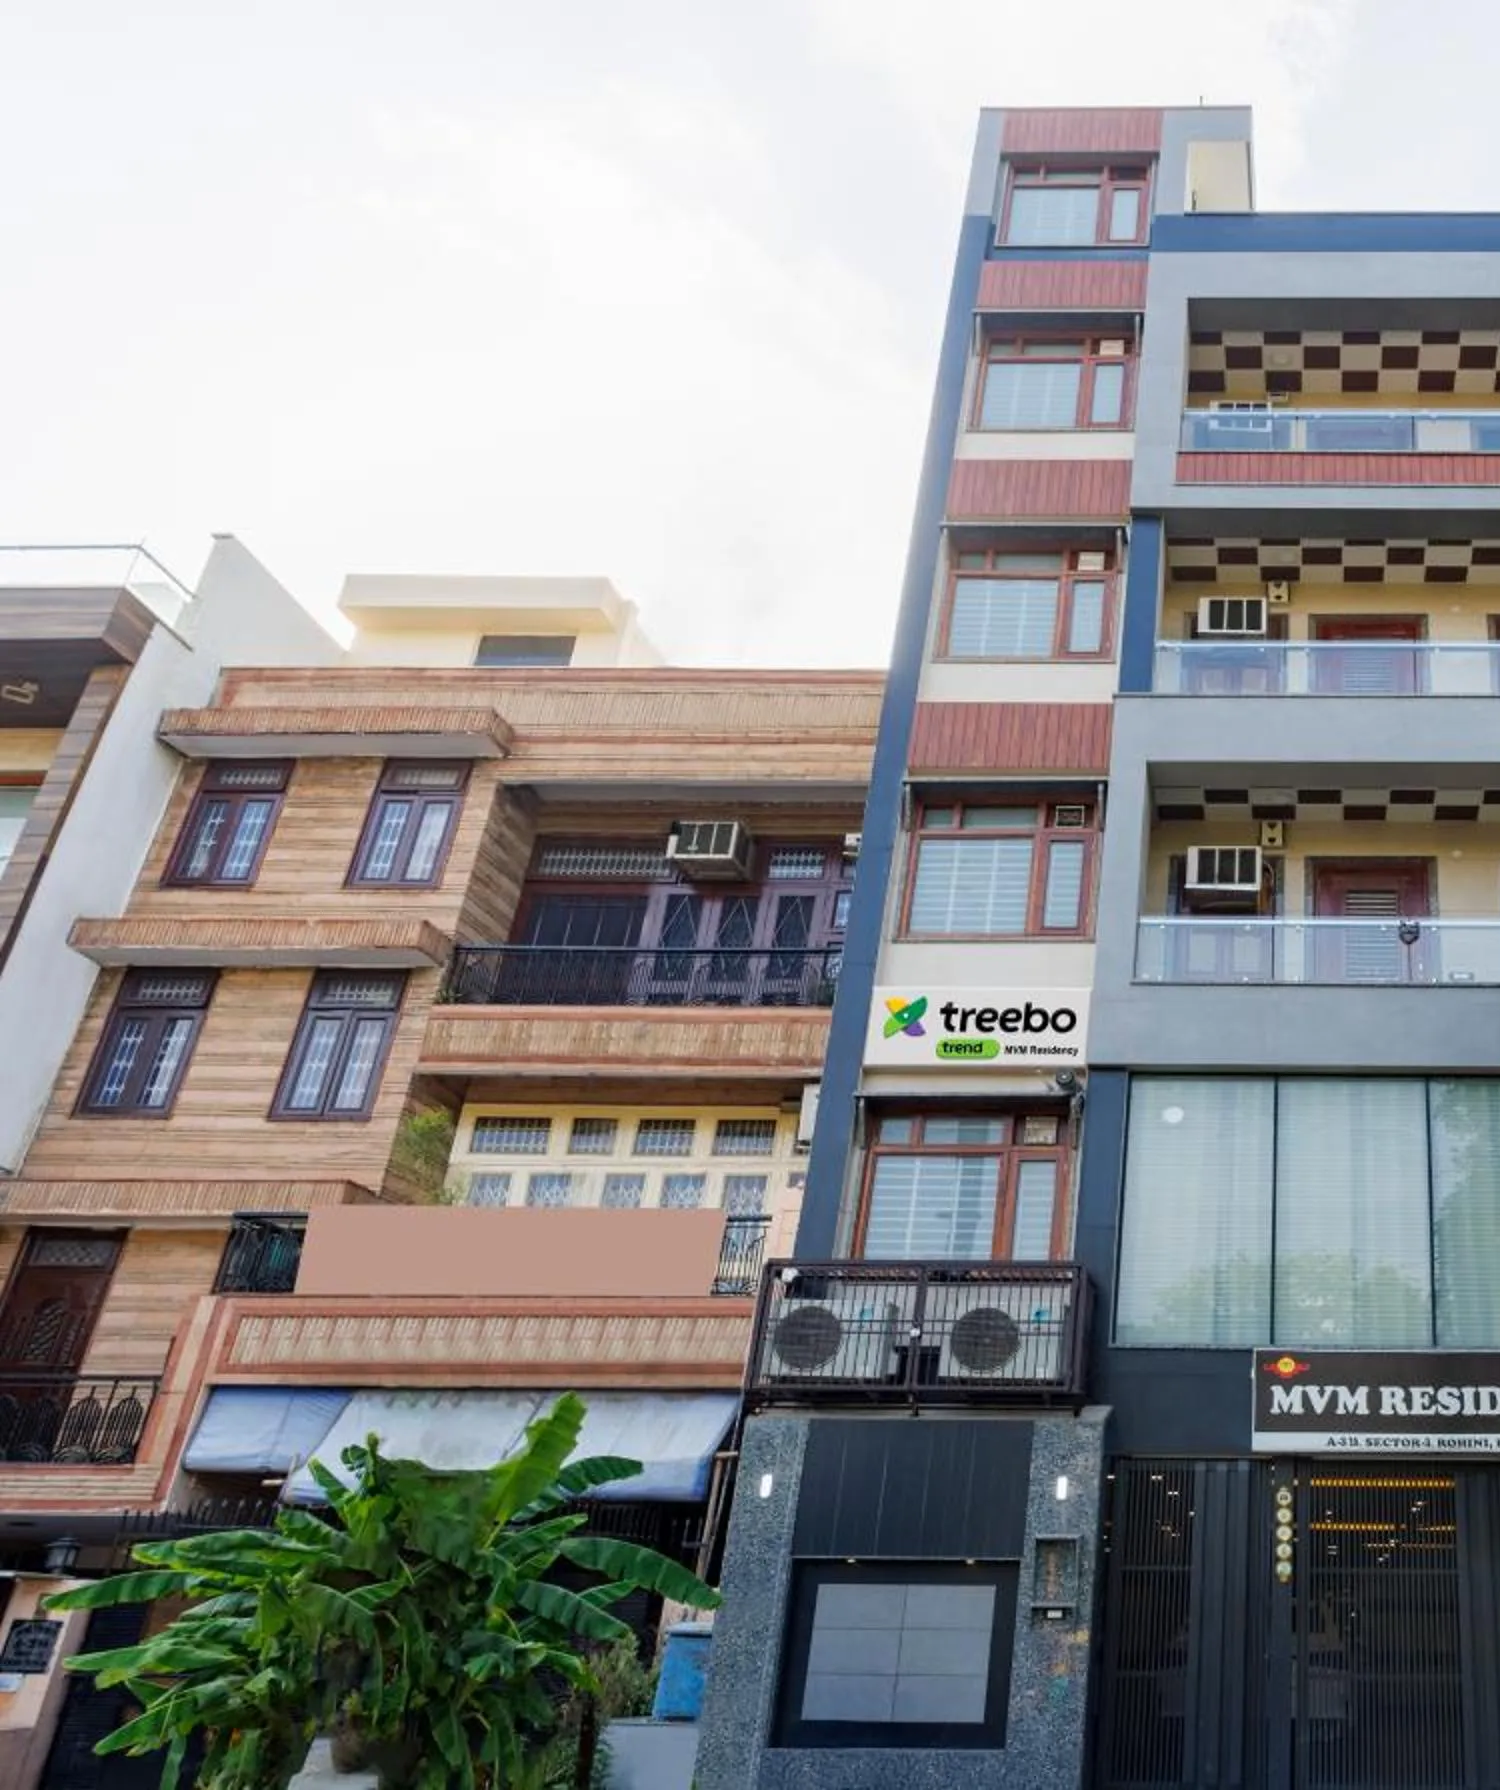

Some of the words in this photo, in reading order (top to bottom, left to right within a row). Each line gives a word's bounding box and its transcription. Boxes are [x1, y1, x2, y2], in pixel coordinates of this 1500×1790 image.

[940, 1002, 1077, 1034] treebo
[943, 1042, 983, 1054] trend
[1004, 1045, 1028, 1055] MVM
[1030, 1045, 1079, 1057] Residency
[1270, 1385, 1369, 1415] MVM
